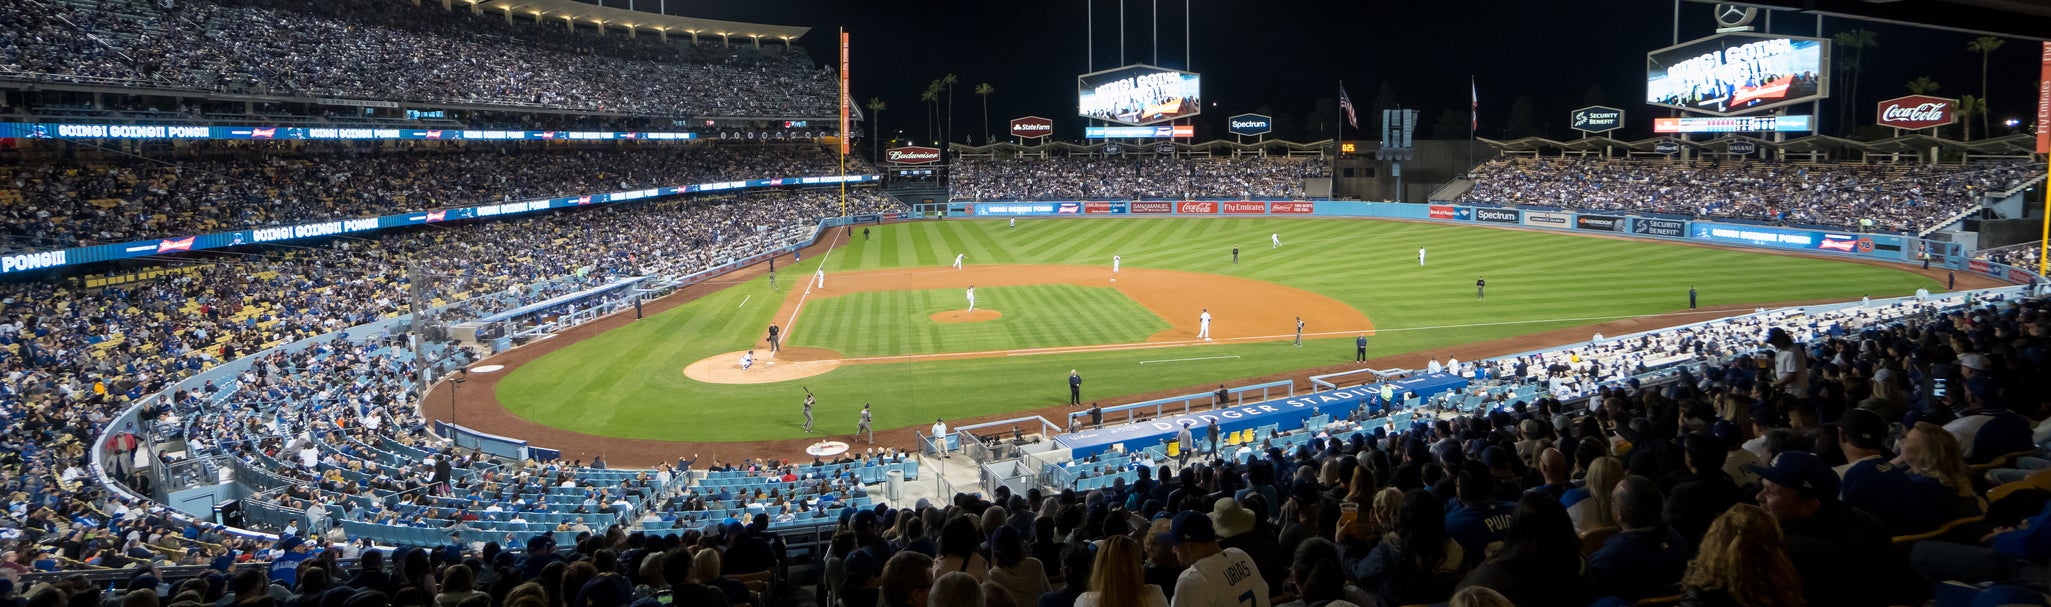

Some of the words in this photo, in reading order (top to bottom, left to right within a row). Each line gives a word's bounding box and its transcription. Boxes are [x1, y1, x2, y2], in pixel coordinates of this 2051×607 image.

[2040, 80, 2049, 116] Emirates
[1883, 103, 1947, 122] Coca-Cola
[1232, 120, 1266, 129] Spectrum
[58, 125, 108, 137] GOING!
[890, 151, 938, 160] Budweiser
[1182, 203, 1212, 212] Coca-Cola
[1225, 204, 1235, 212] Fly
[1478, 210, 1515, 220] Spectrum
[1649, 220, 1681, 229] SECURITY
[253, 226, 294, 242] GOING!
[1648, 227, 1677, 235] BENEFIT
[1861, 241, 1870, 249] 76
[1, 250, 66, 273] PONG!!!
[1152, 405, 1279, 431] DODGER
